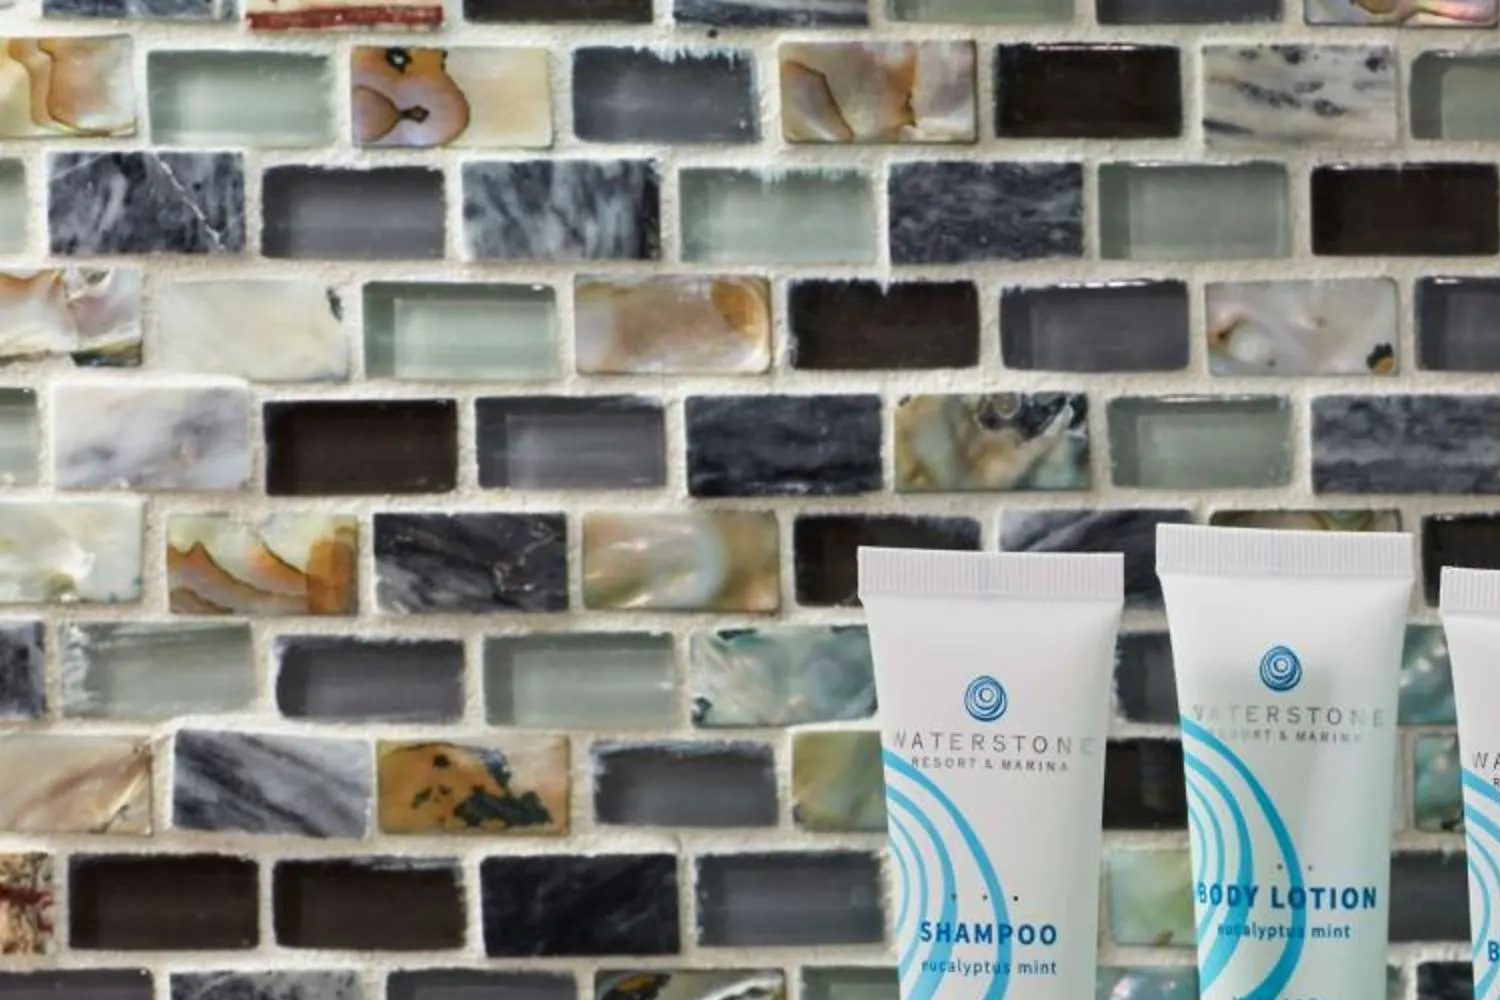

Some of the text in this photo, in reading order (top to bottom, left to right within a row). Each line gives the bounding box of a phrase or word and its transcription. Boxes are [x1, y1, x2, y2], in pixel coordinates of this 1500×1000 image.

[911, 757, 1069, 773] RESORT & MARINA
[1197, 883, 1377, 910] BODY LOTION
[920, 921, 1057, 946] SHAMPOO
[1311, 924, 1351, 939] mint
[1018, 961, 1056, 975] mint
